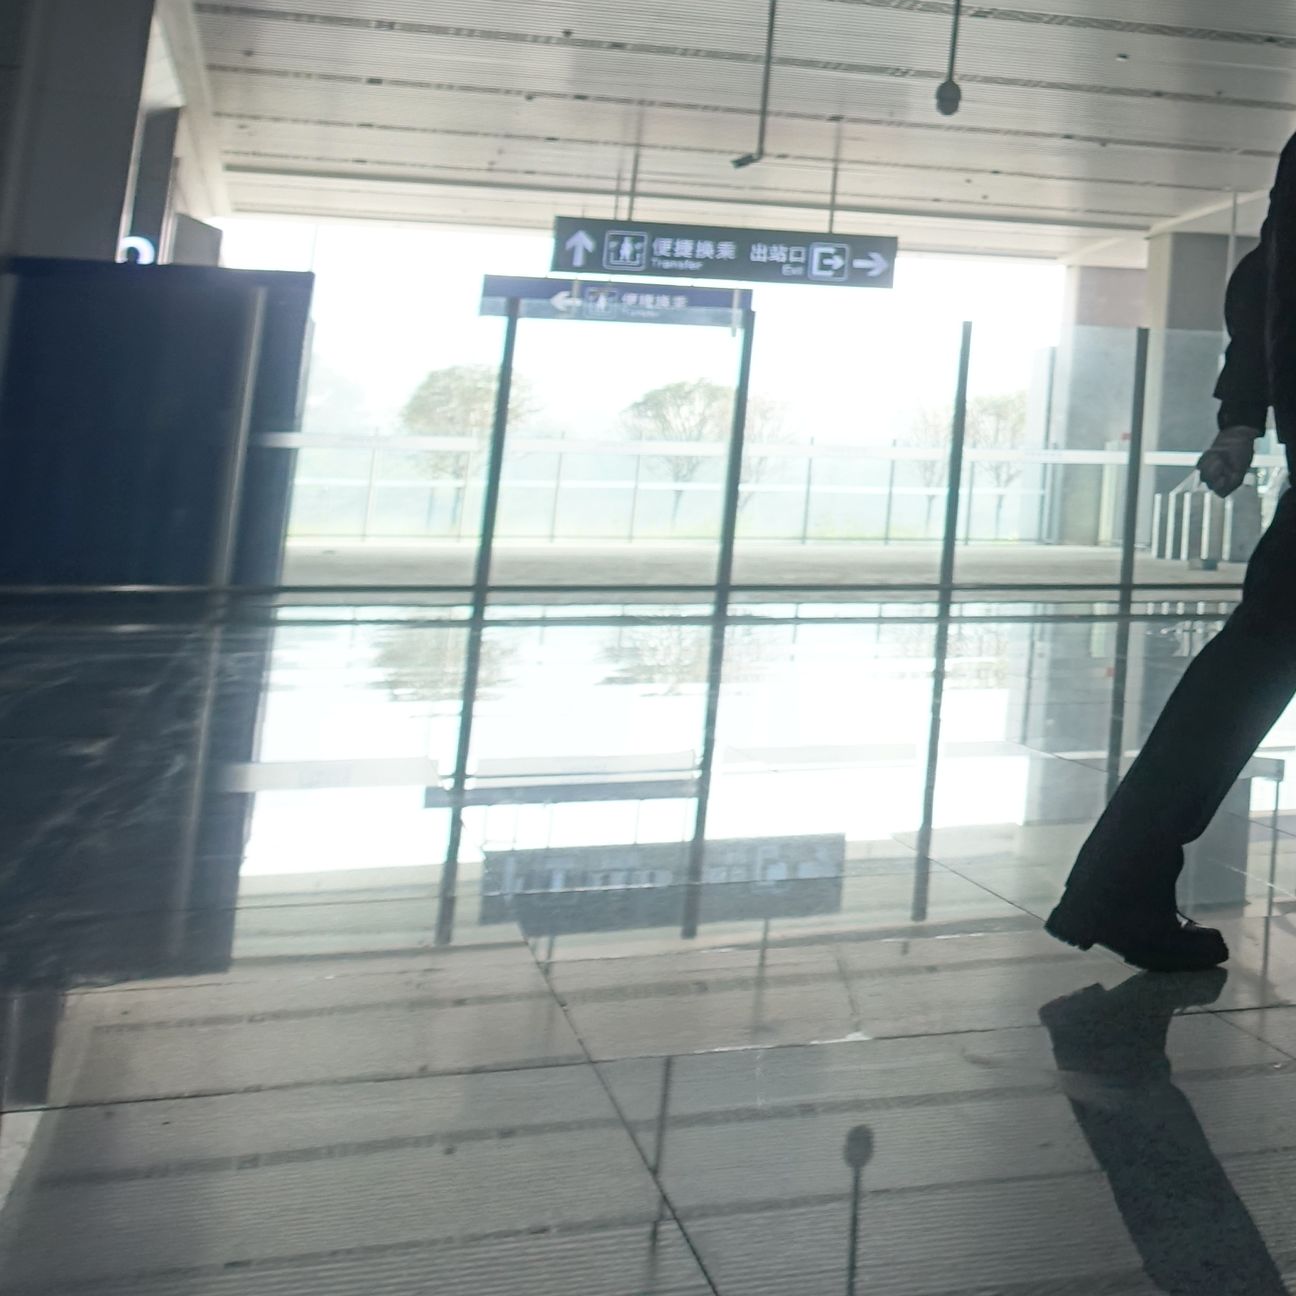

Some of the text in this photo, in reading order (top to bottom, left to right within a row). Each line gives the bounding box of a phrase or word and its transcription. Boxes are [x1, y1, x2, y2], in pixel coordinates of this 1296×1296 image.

[652, 237, 736, 261] 便捷换乘
[749, 242, 806, 264] 出站口
[651, 257, 704, 271] Transfer
